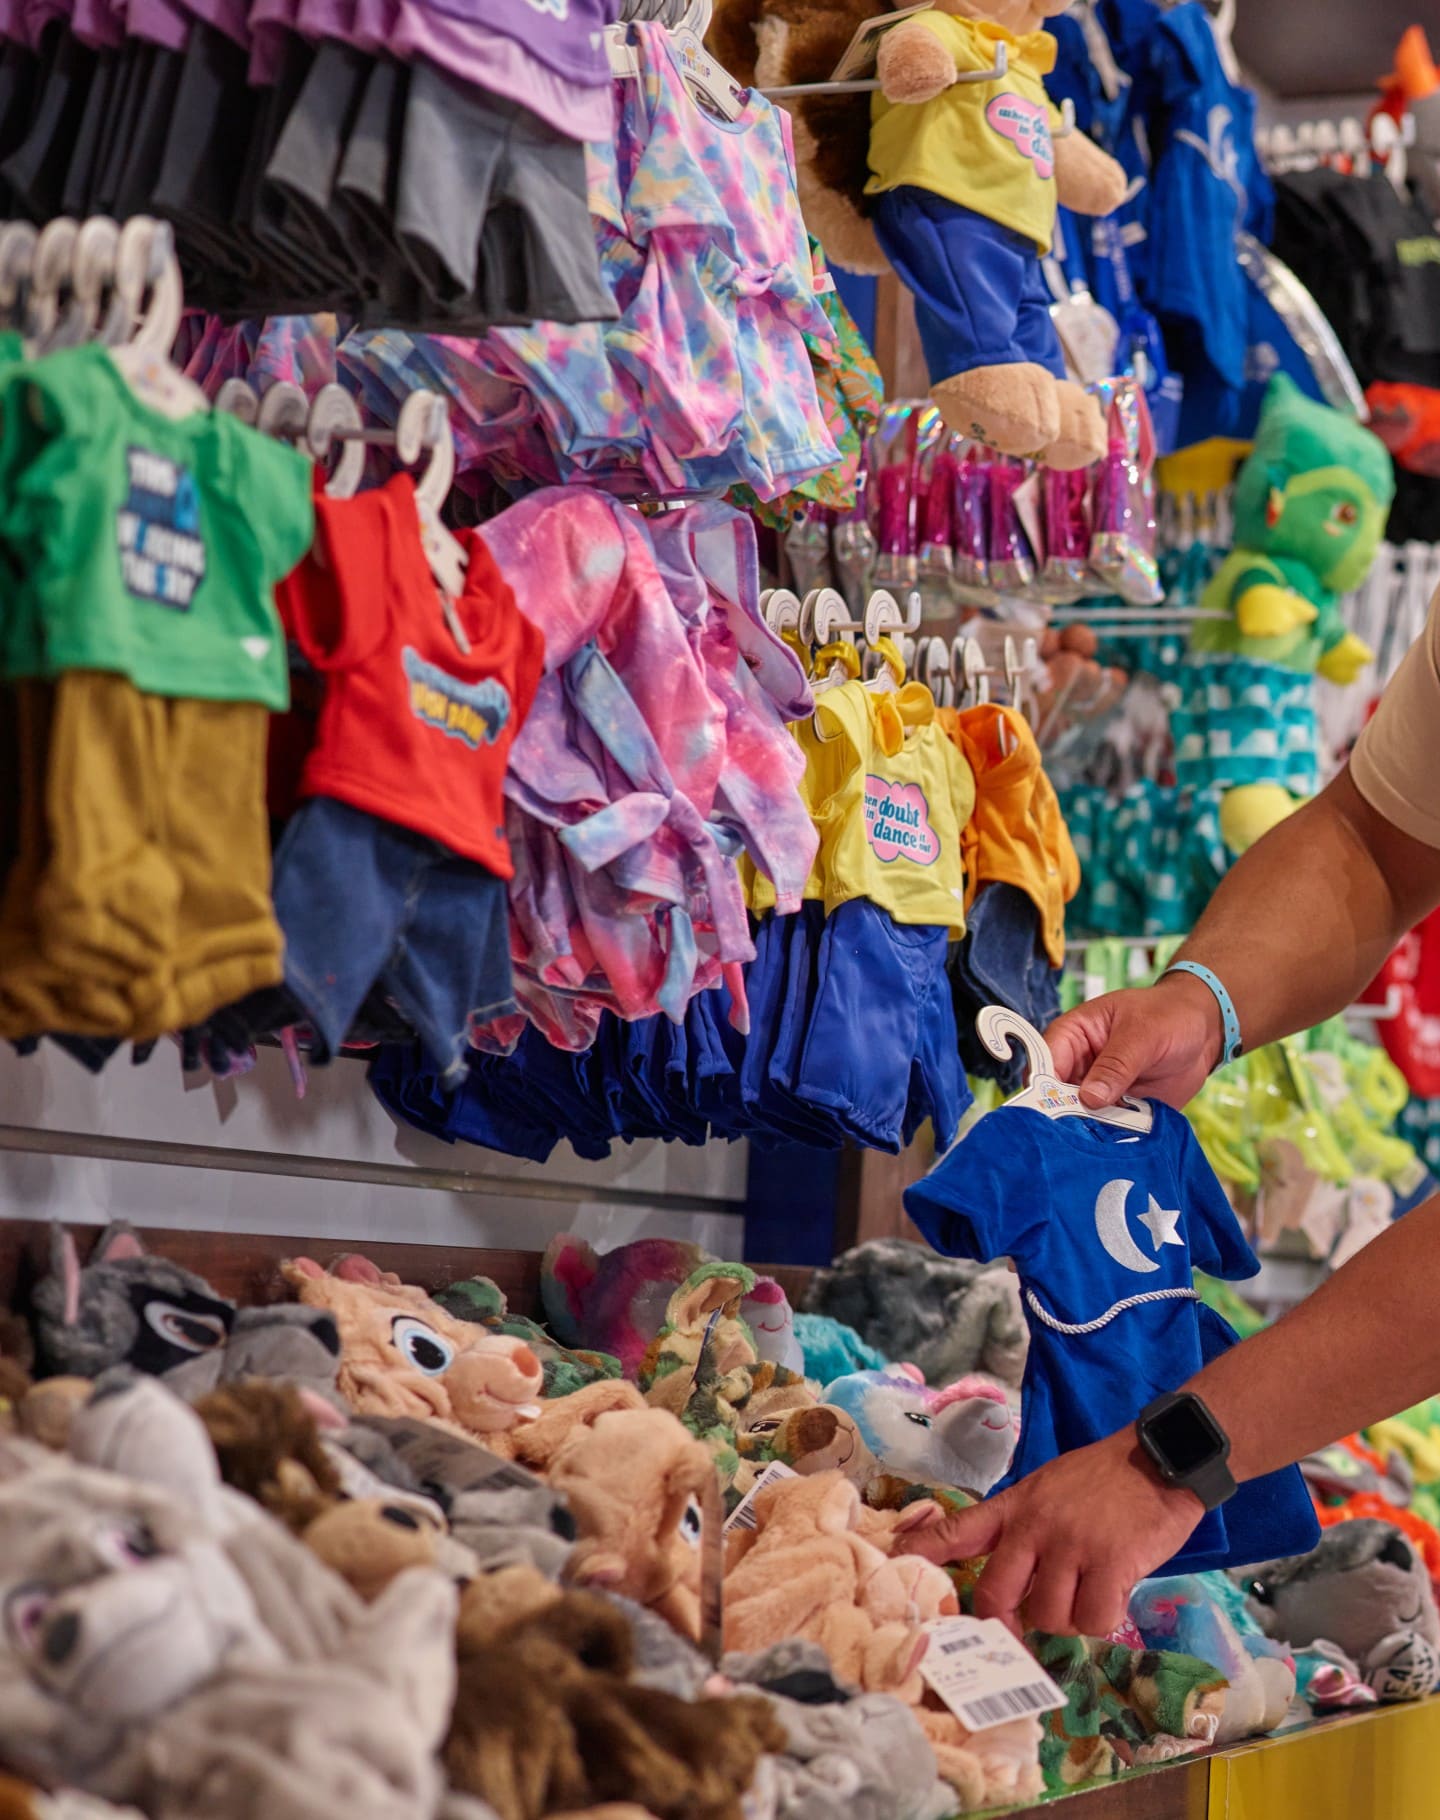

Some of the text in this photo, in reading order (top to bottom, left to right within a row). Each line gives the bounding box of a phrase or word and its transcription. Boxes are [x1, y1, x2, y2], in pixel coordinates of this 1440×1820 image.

[866, 807, 874, 820] in
[879, 796, 919, 828] doubt
[873, 817, 917, 848] dance
